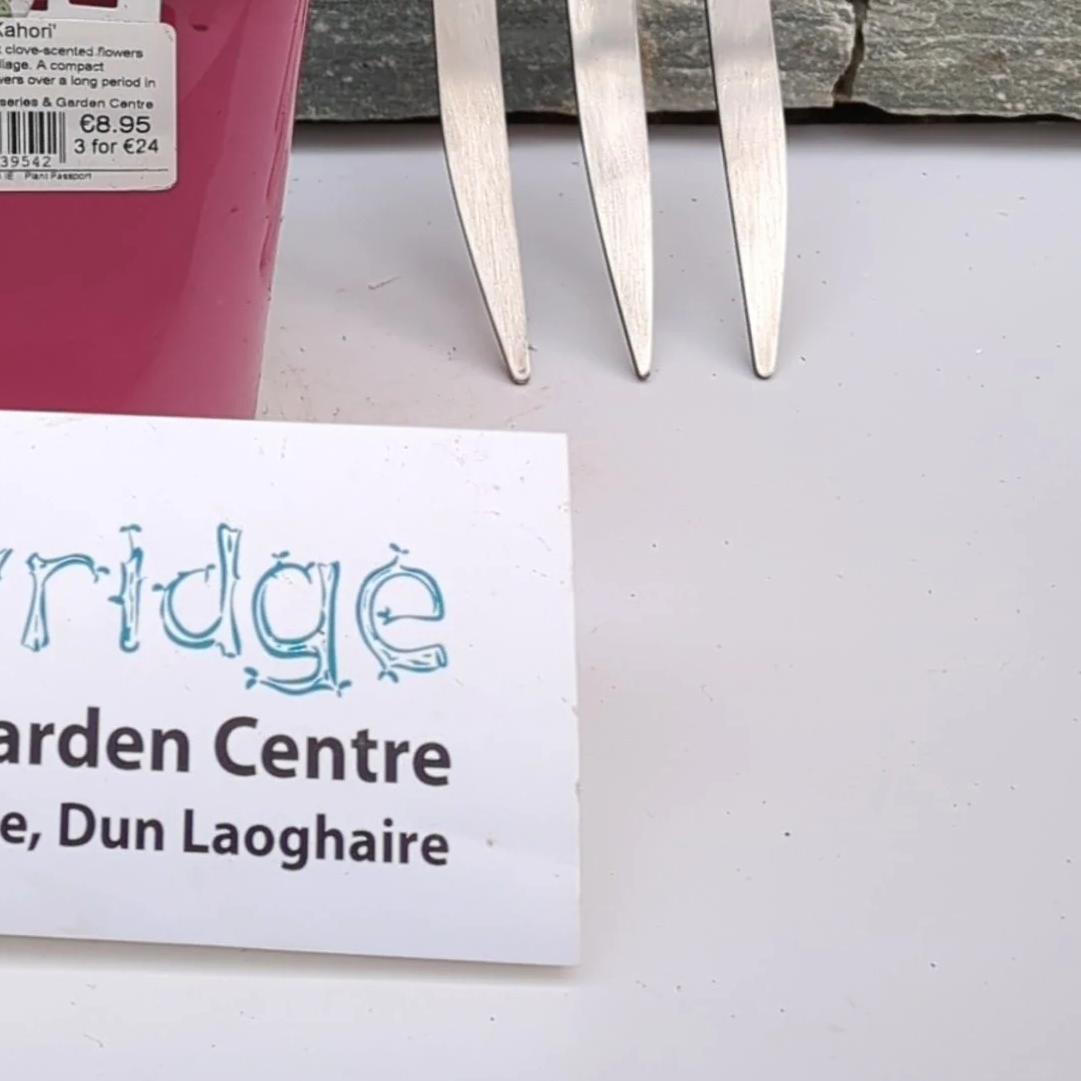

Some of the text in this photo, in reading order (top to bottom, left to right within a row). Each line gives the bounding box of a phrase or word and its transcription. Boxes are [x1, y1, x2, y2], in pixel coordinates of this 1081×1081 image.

[5, 44, 94, 58] clove-scented
[98, 46, 144, 59] flowers
[36, 60, 47, 70] A
[50, 61, 105, 74] compact
[27, 76, 56, 86] over
[58, 76, 67, 86] a
[70, 75, 98, 89] long
[102, 76, 141, 90] period
[144, 77, 156, 89] in
[42, 96, 52, 108] &
[56, 97, 106, 109] Garden
[109, 98, 154, 110] Centre
[80, 114, 151, 134] €8.95
[74, 138, 159, 154] 3 for €24
[214, 715, 452, 787] Centre
[59, 802, 164, 852] Dun
[182, 808, 450, 871] Laoghaire
